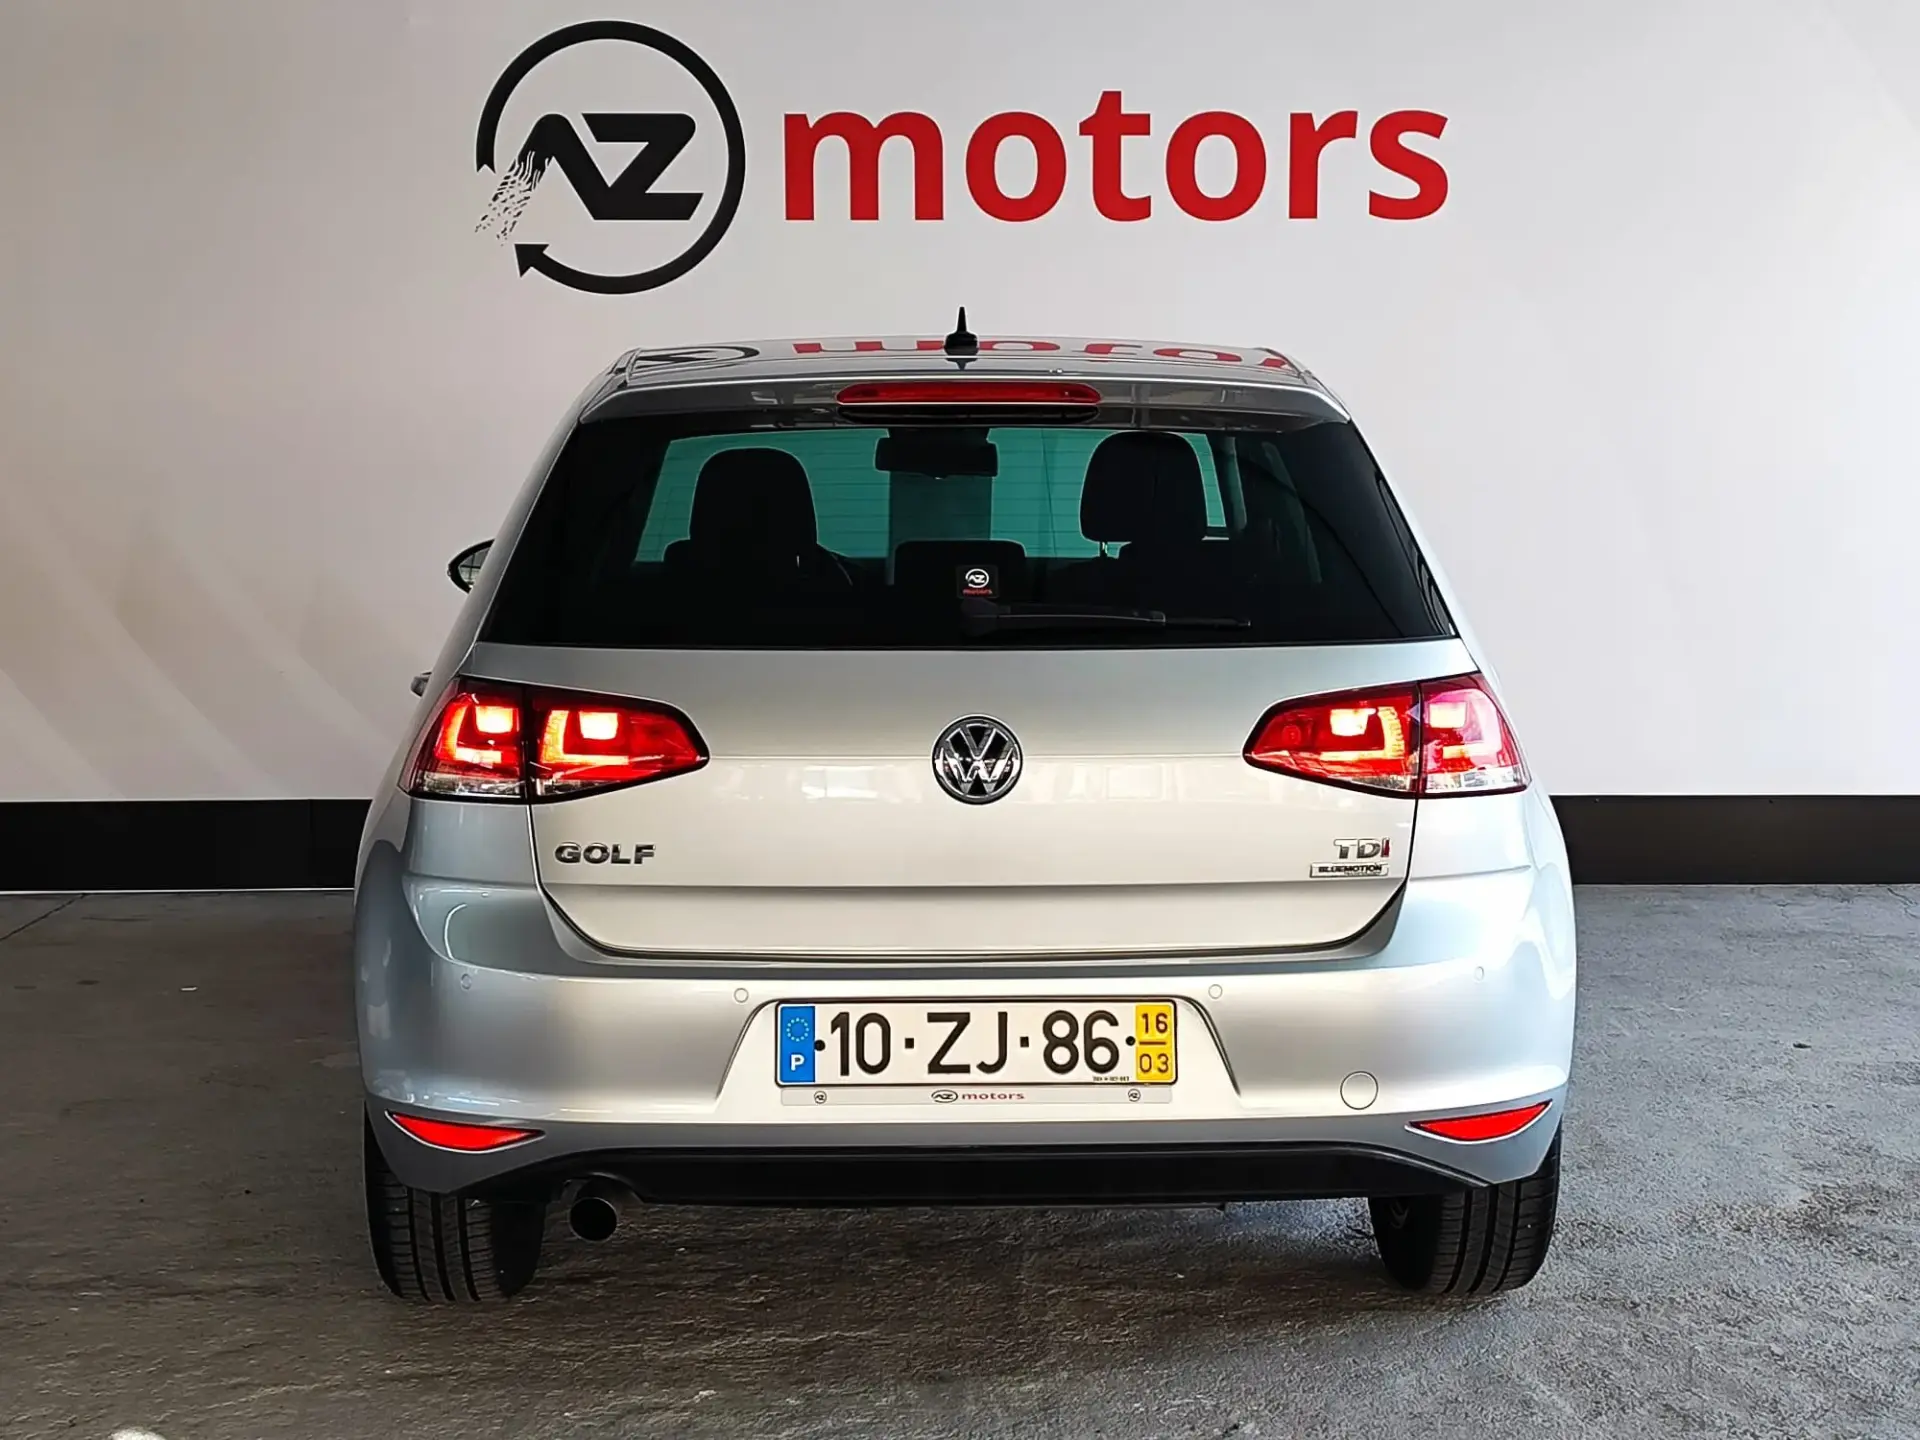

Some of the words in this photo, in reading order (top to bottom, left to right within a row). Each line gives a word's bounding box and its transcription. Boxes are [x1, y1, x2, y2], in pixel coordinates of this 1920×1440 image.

[784, 91, 1449, 222] motors
[554, 841, 656, 865] GOLF
[1333, 838, 1390, 859] TDI
[1142, 1012, 1168, 1034] 16
[791, 1054, 805, 1071] P
[1139, 1053, 1169, 1073] 03
[962, 1092, 1025, 1100] motors
